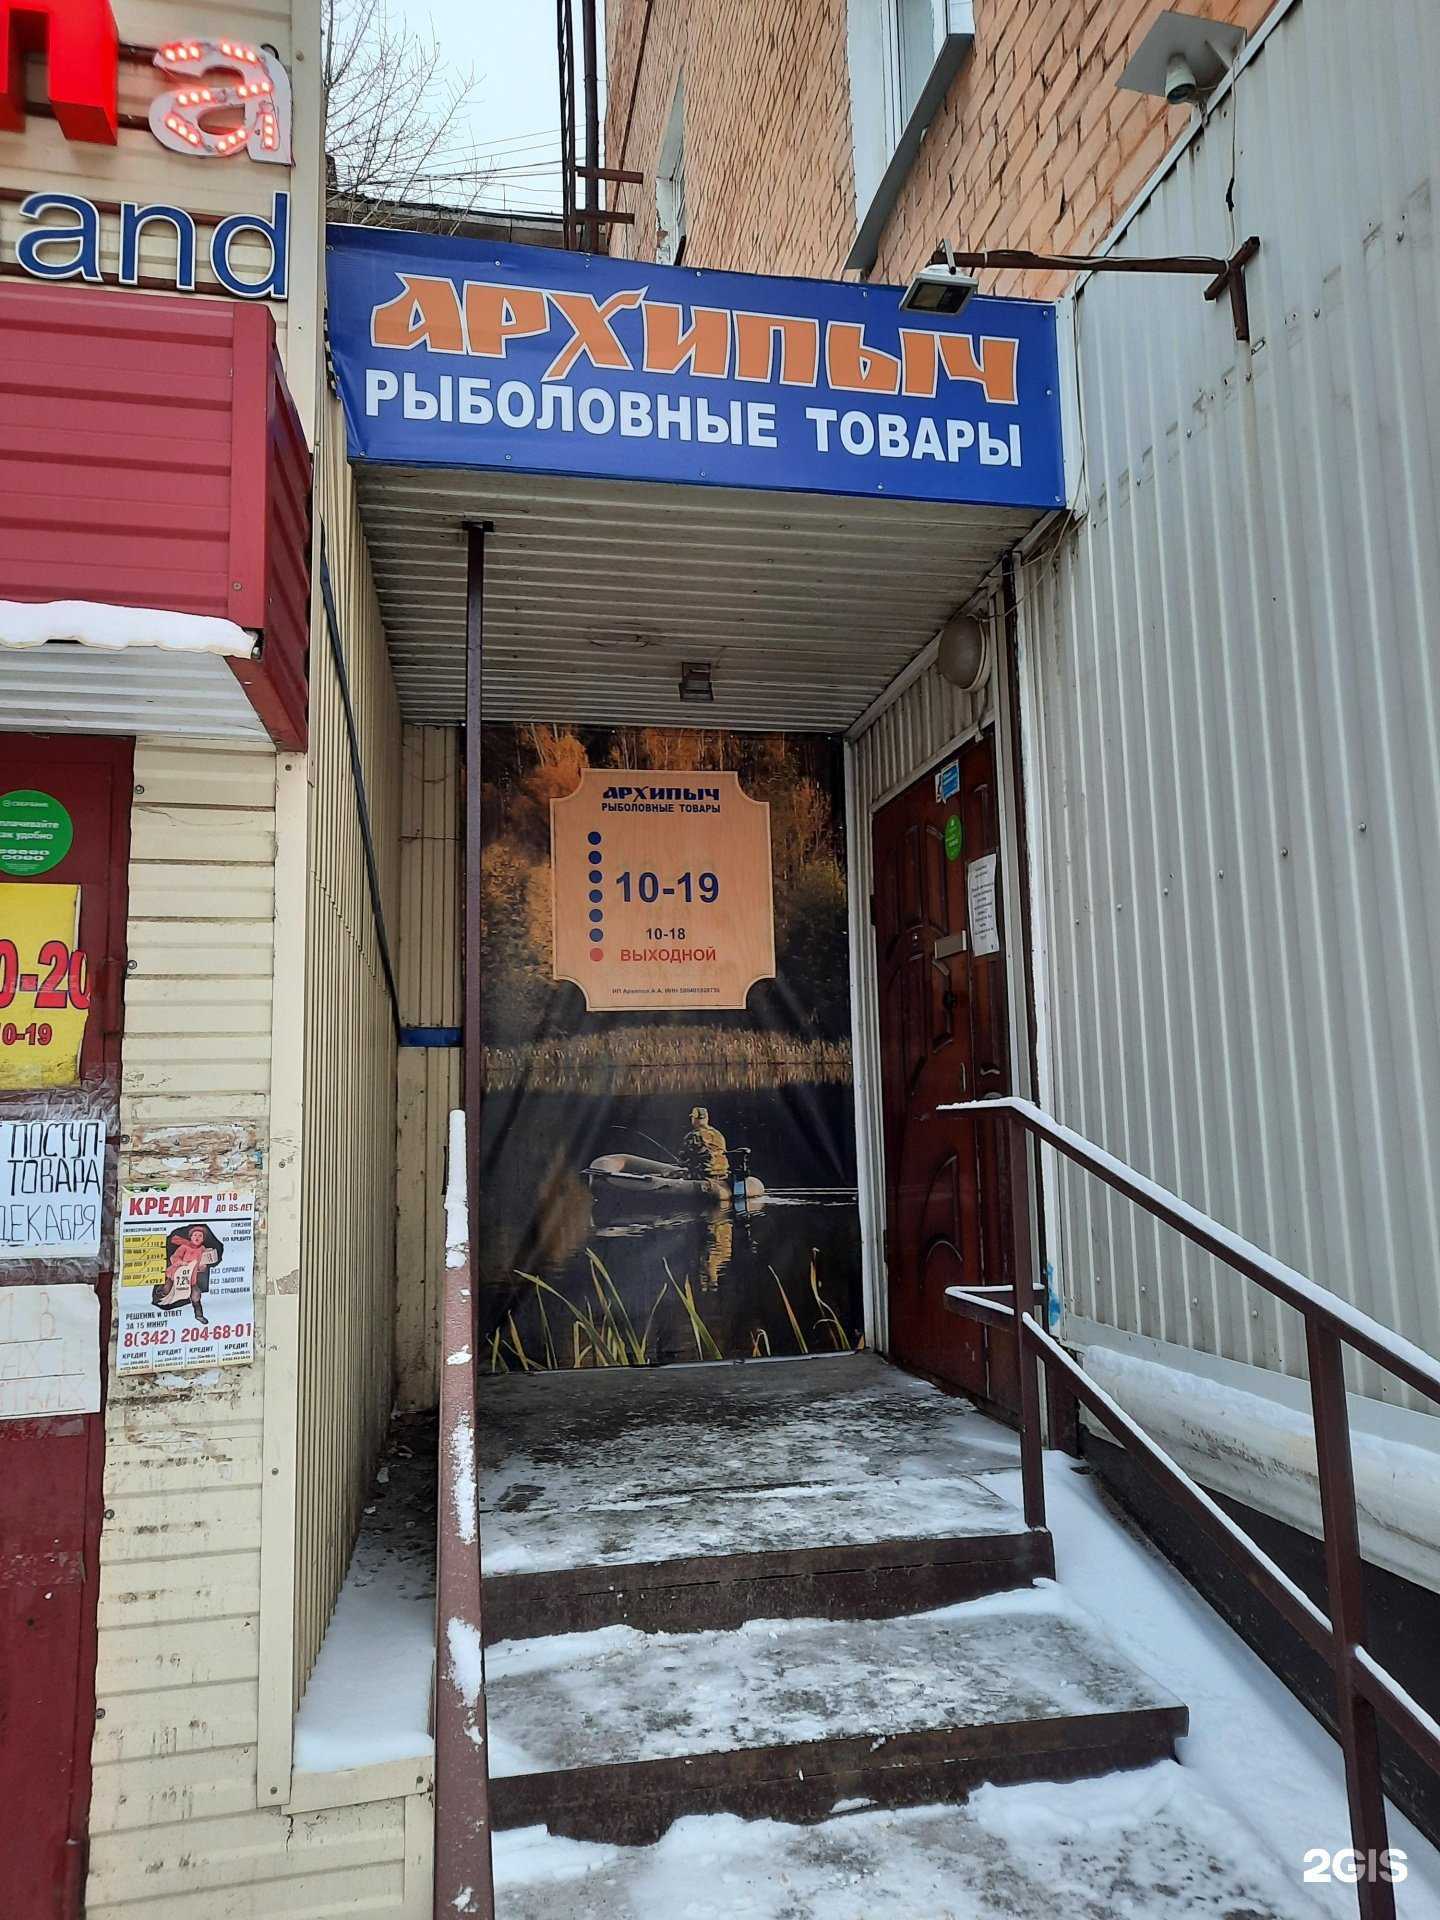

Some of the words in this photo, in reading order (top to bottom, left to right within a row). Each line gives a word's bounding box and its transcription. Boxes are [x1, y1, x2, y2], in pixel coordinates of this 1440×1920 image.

[15, 190, 290, 300] and
[369, 271, 1020, 406] АРХИПЫЧ
[365, 368, 778, 449] РЫБОЛОВНЫЕ
[805, 407, 1023, 467] ТОВАРЫ
[603, 786, 720, 802] АРХИПЫЧ
[602, 803, 675, 813] РЫБОЛОВНЫЕ
[680, 804, 721, 813] ТОВАРЫ
[616, 872, 719, 903] 10-19
[646, 928, 686, 940] 10-18
[620, 946, 717, 963] ВЫХОДНОЙ
[8, 1158, 101, 1196] ТОВАРА
[217, 1193, 226, 1201] ОТ
[229, 1193, 238, 1201] 18
[129, 1195, 213, 1217] КРЕДИТ
[216, 1204, 226, 1213] ДО
[240, 1203, 253, 1211] ЛЕТ
[126, 1312, 156, 1320] РЕШЕНИЕ
[163, 1310, 183, 1318] ОТВЕТ
[136, 1321, 145, 1329] 15
[146, 1320, 168, 1328] МИНУТ
[124, 1329, 176, 1347] 8(342)
[181, 1323, 252, 1342] 204-68-01
[157, 1348, 182, 1356] КРЕДИТ
[224, 1342, 249, 1350] КРЕДИТ
